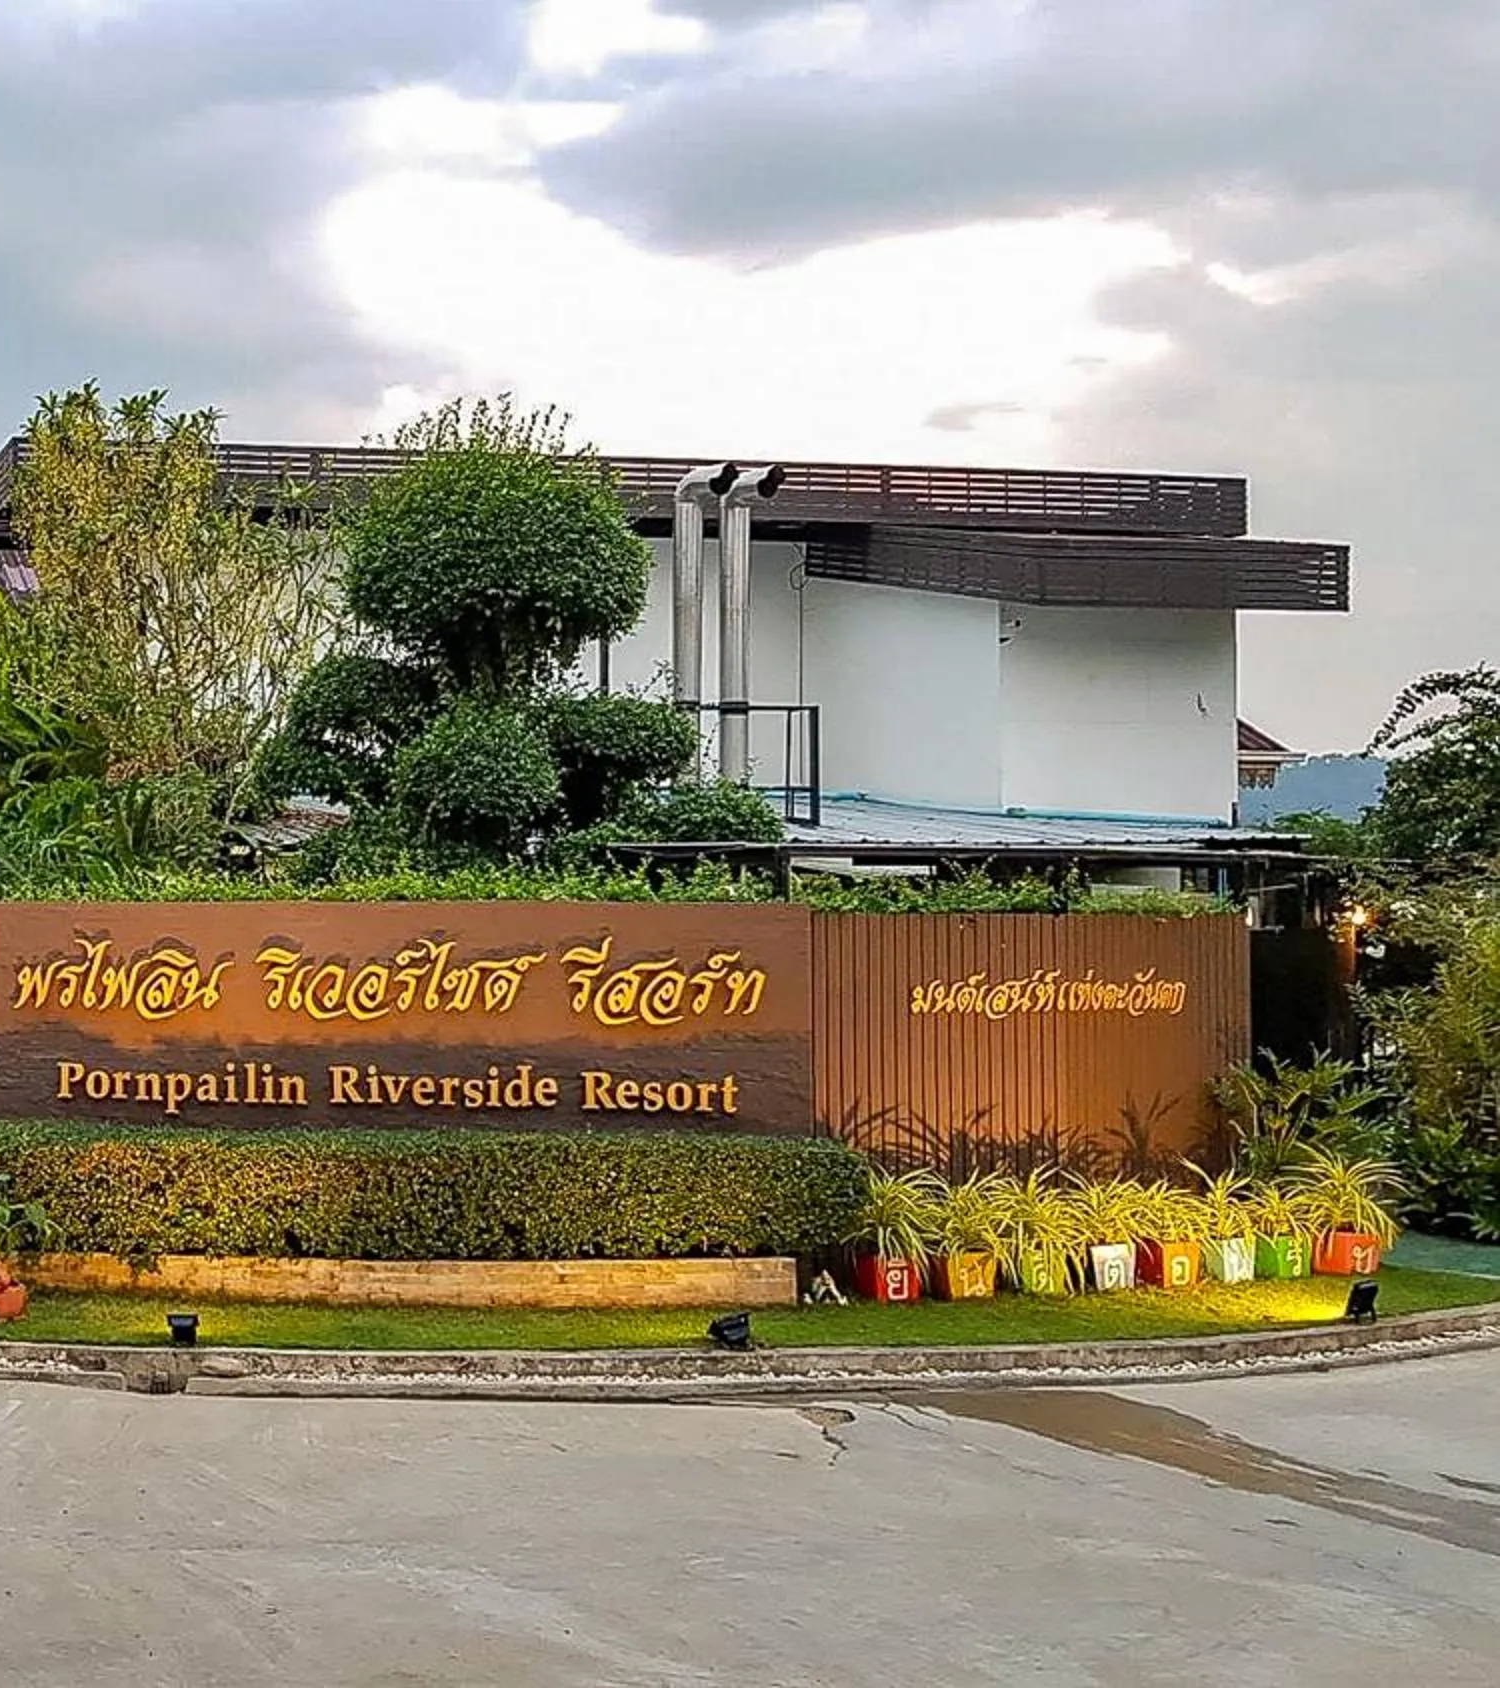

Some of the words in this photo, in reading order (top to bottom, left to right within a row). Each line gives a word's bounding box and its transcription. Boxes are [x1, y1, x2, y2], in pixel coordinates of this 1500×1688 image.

[13, 939, 236, 1021] พรไพลิน
[255, 938, 548, 1022] ริเวอร์ไซด์
[560, 936, 766, 1026] รีสอร์ท
[56, 1061, 308, 1116] Pornpailin
[328, 1064, 559, 1109] Riverside
[581, 1070, 739, 1113] Resort
